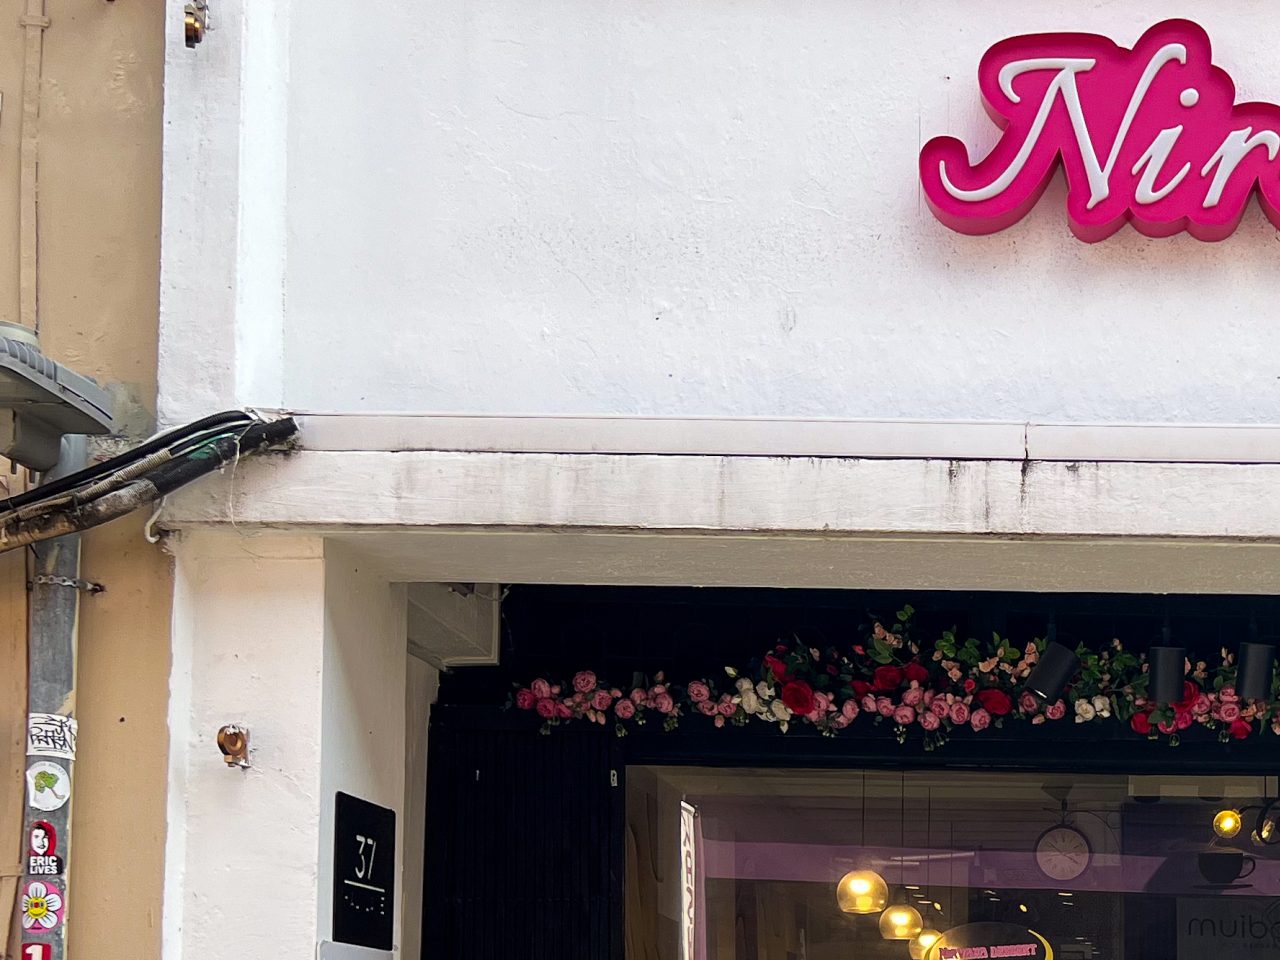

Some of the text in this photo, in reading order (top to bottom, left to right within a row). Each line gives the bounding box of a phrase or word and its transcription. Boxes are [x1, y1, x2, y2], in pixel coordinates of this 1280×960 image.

[29, 856, 58, 867] ERIC
[355, 834, 378, 879] 37
[29, 866, 58, 875] LIVES
